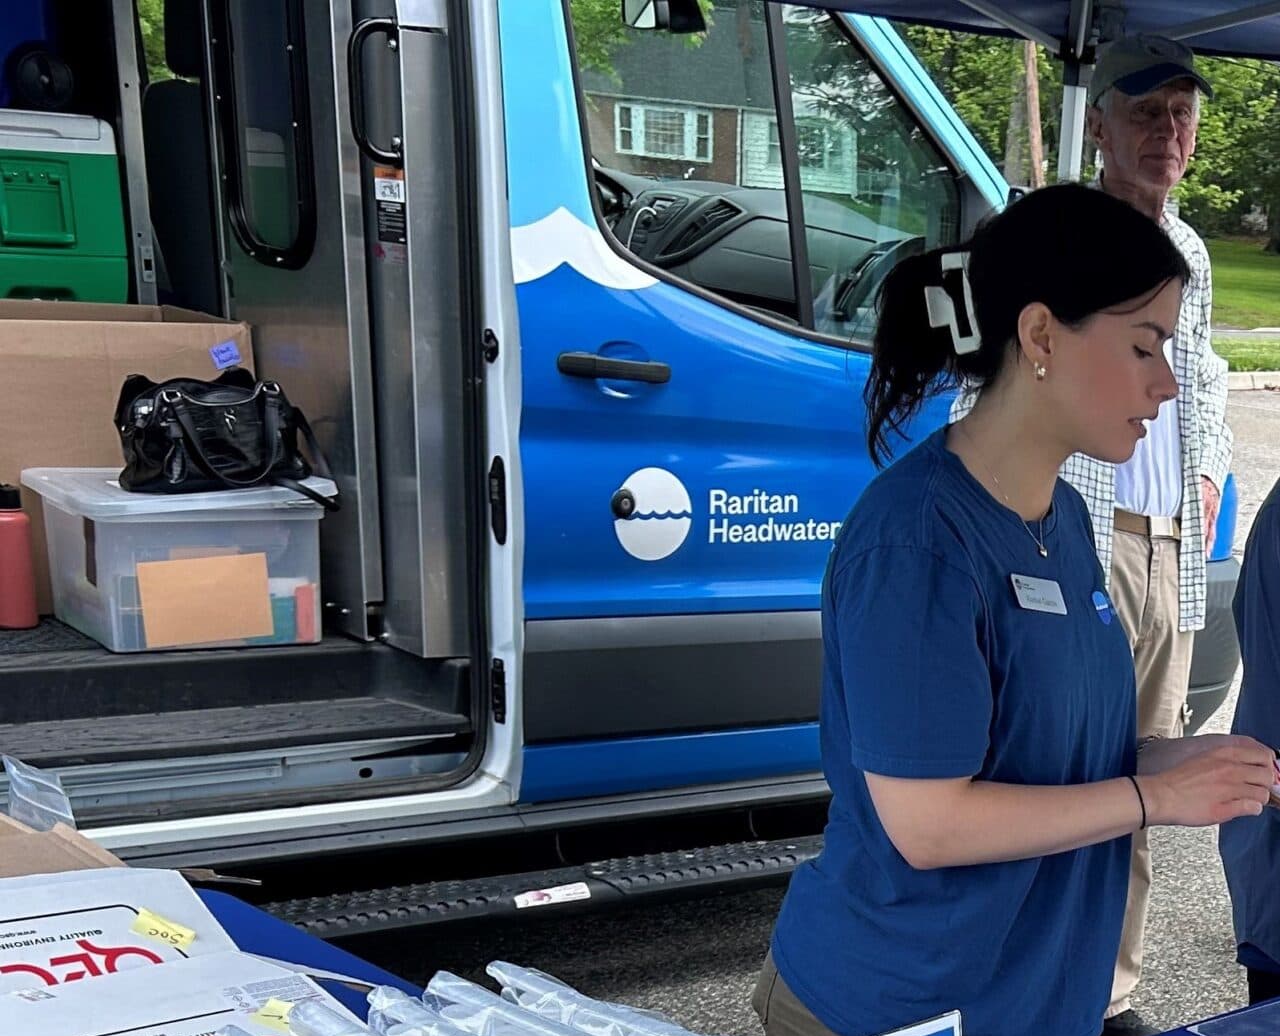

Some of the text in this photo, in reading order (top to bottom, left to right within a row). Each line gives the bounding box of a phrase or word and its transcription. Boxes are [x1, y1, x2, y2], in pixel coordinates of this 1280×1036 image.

[709, 489, 798, 515] Raritan
[708, 517, 843, 544] Headwater
[58, 929, 103, 943] QUALITY
